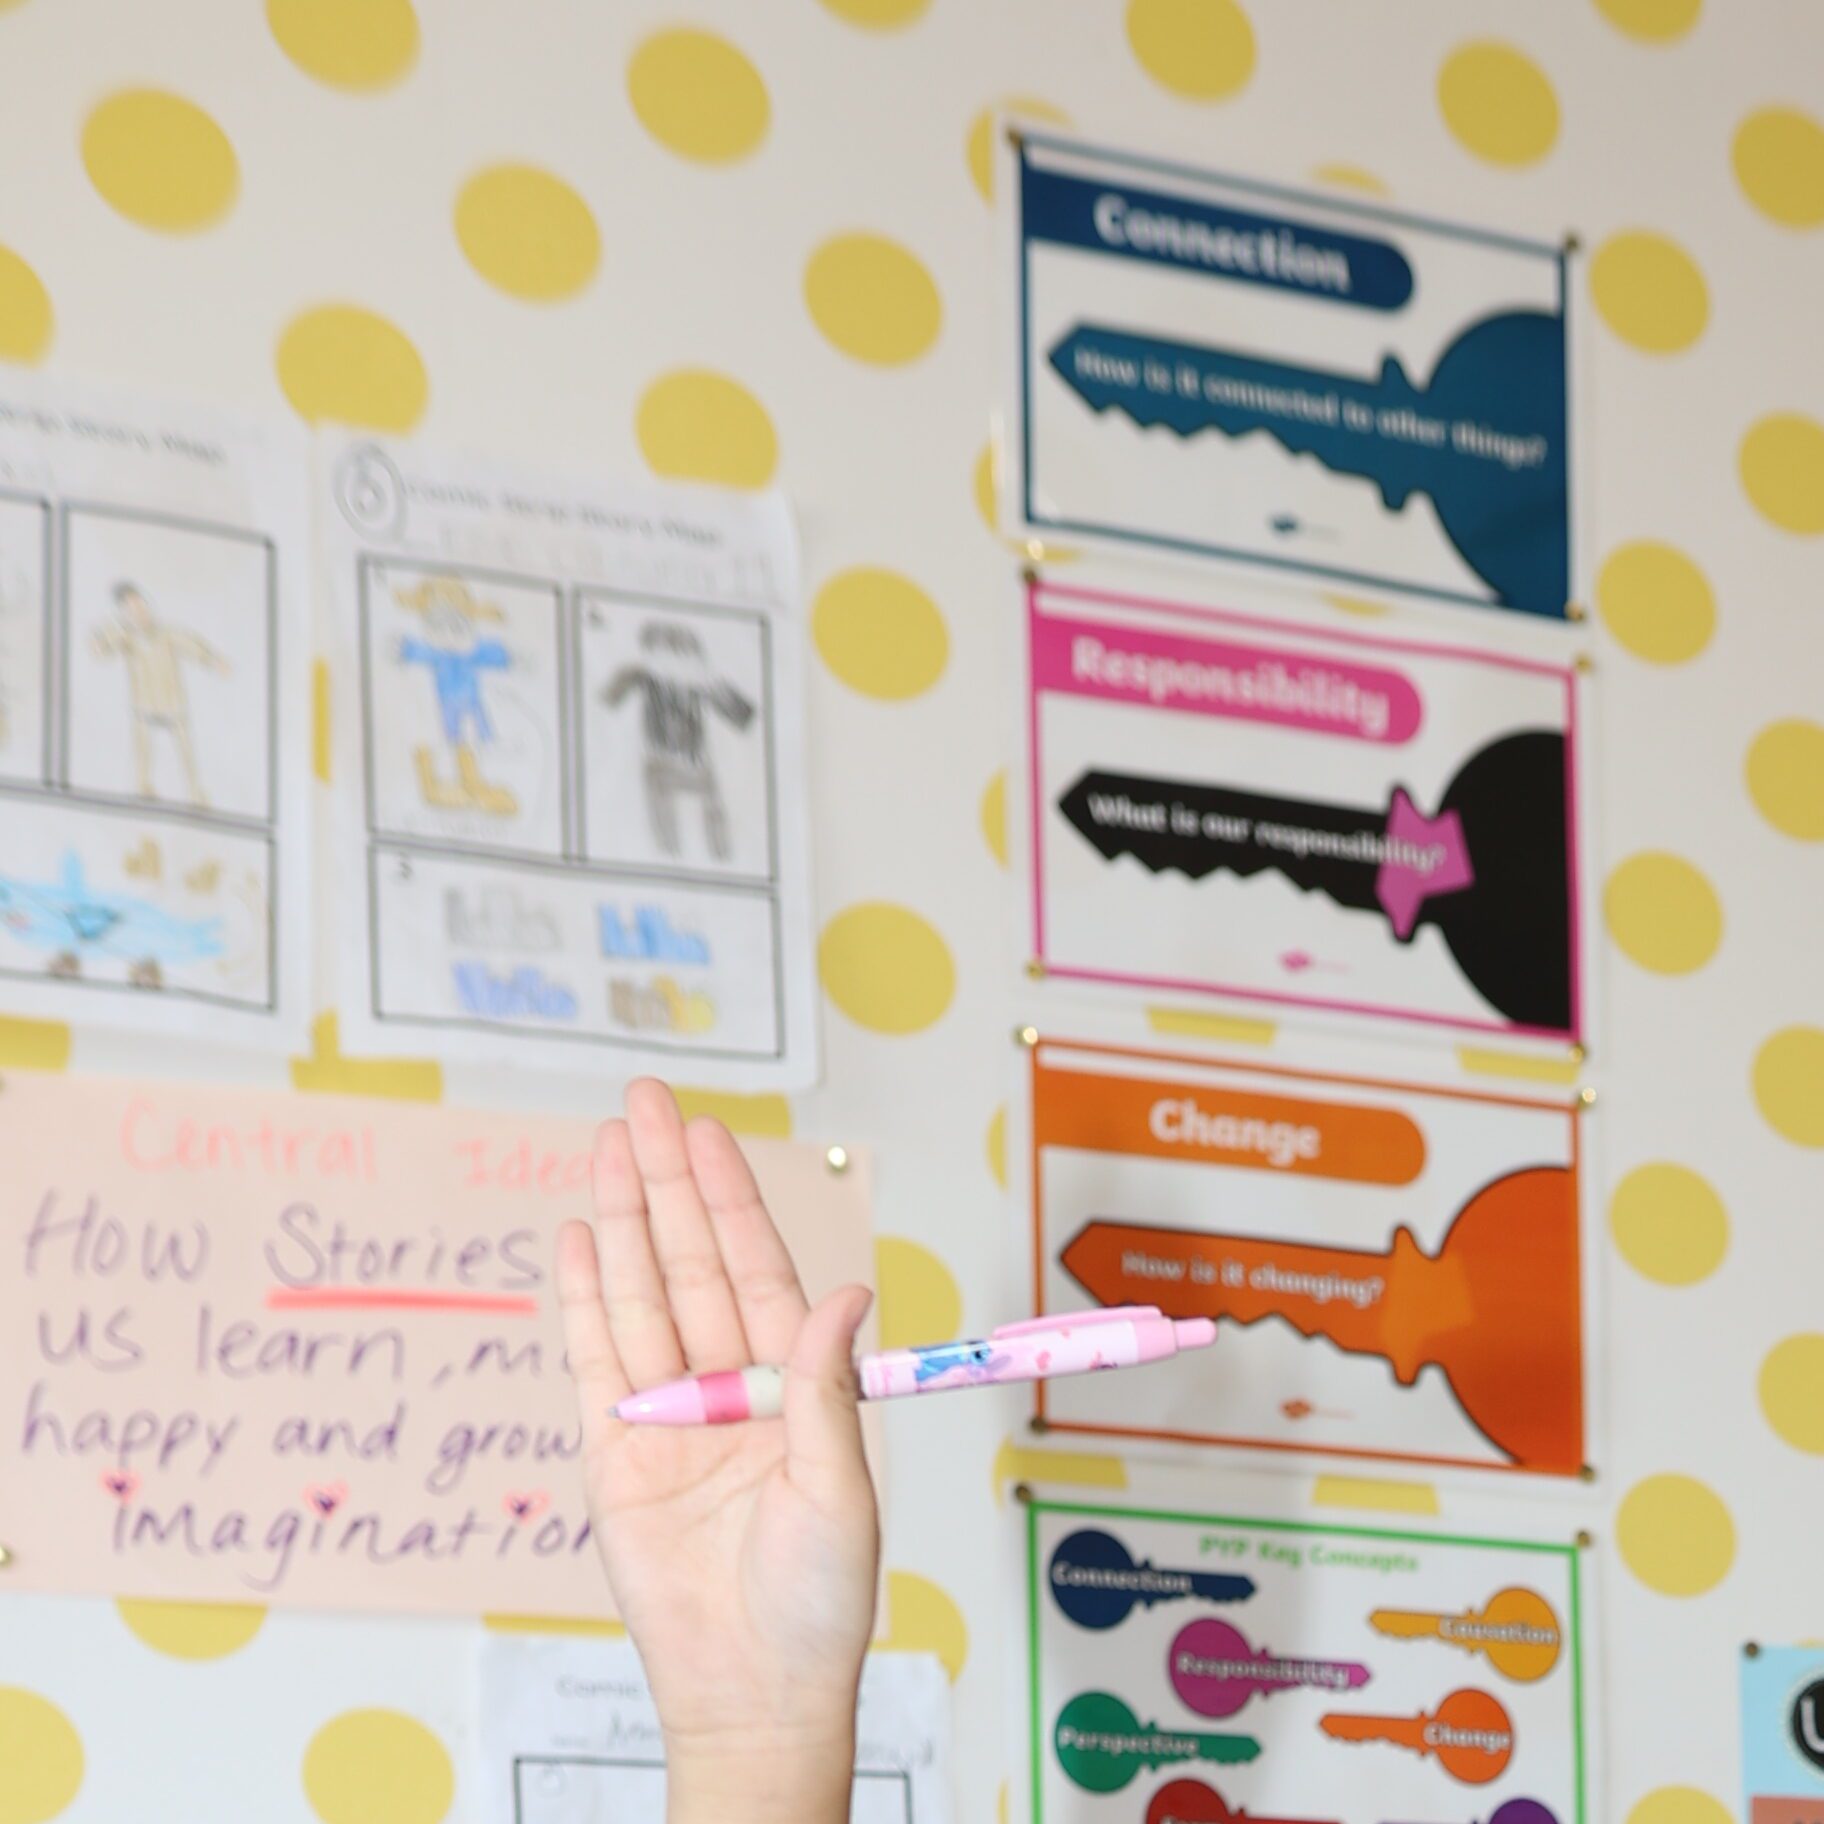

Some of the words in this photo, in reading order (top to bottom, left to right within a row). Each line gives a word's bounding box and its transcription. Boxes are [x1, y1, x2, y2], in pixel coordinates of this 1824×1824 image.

[1094, 193, 1350, 293] Connection
[1075, 346, 1136, 387] How
[1144, 357, 1171, 392] is
[1175, 361, 1200, 398] it
[1203, 370, 1338, 426] connected
[1343, 395, 1373, 434] to
[1376, 406, 1446, 448] other
[1451, 419, 1548, 470] things?
[1073, 636, 1390, 738] Responsibility
[1088, 792, 1167, 830] What
[1171, 804, 1197, 831] is
[1203, 816, 1249, 845] our
[1256, 822, 1447, 875] responsibility?
[120, 1098, 381, 1181] Central
[1149, 1097, 1321, 1166] Change
[23, 1189, 212, 1284] How
[264, 1202, 546, 1291] Stories
[1122, 1251, 1186, 1280] How
[1192, 1254, 1216, 1282] is
[1222, 1256, 1246, 1287] it
[1251, 1262, 1385, 1309] changing?
[38, 1304, 146, 1372] us
[466, 1332, 584, 1376] m
[21, 1380, 241, 1472] happy
[273, 1404, 402, 1462] and
[425, 1411, 585, 1496] grow
[1052, 1562, 1193, 1594] Connection
[1200, 1534, 1249, 1558] PYP
[1257, 1539, 1304, 1568] Key
[1310, 1544, 1420, 1574] Concepts
[1439, 1617, 1560, 1645] Causation
[1176, 1653, 1350, 1689] Responsibility
[1057, 1727, 1199, 1758] Perspective
[1424, 1724, 1511, 1752] Change
